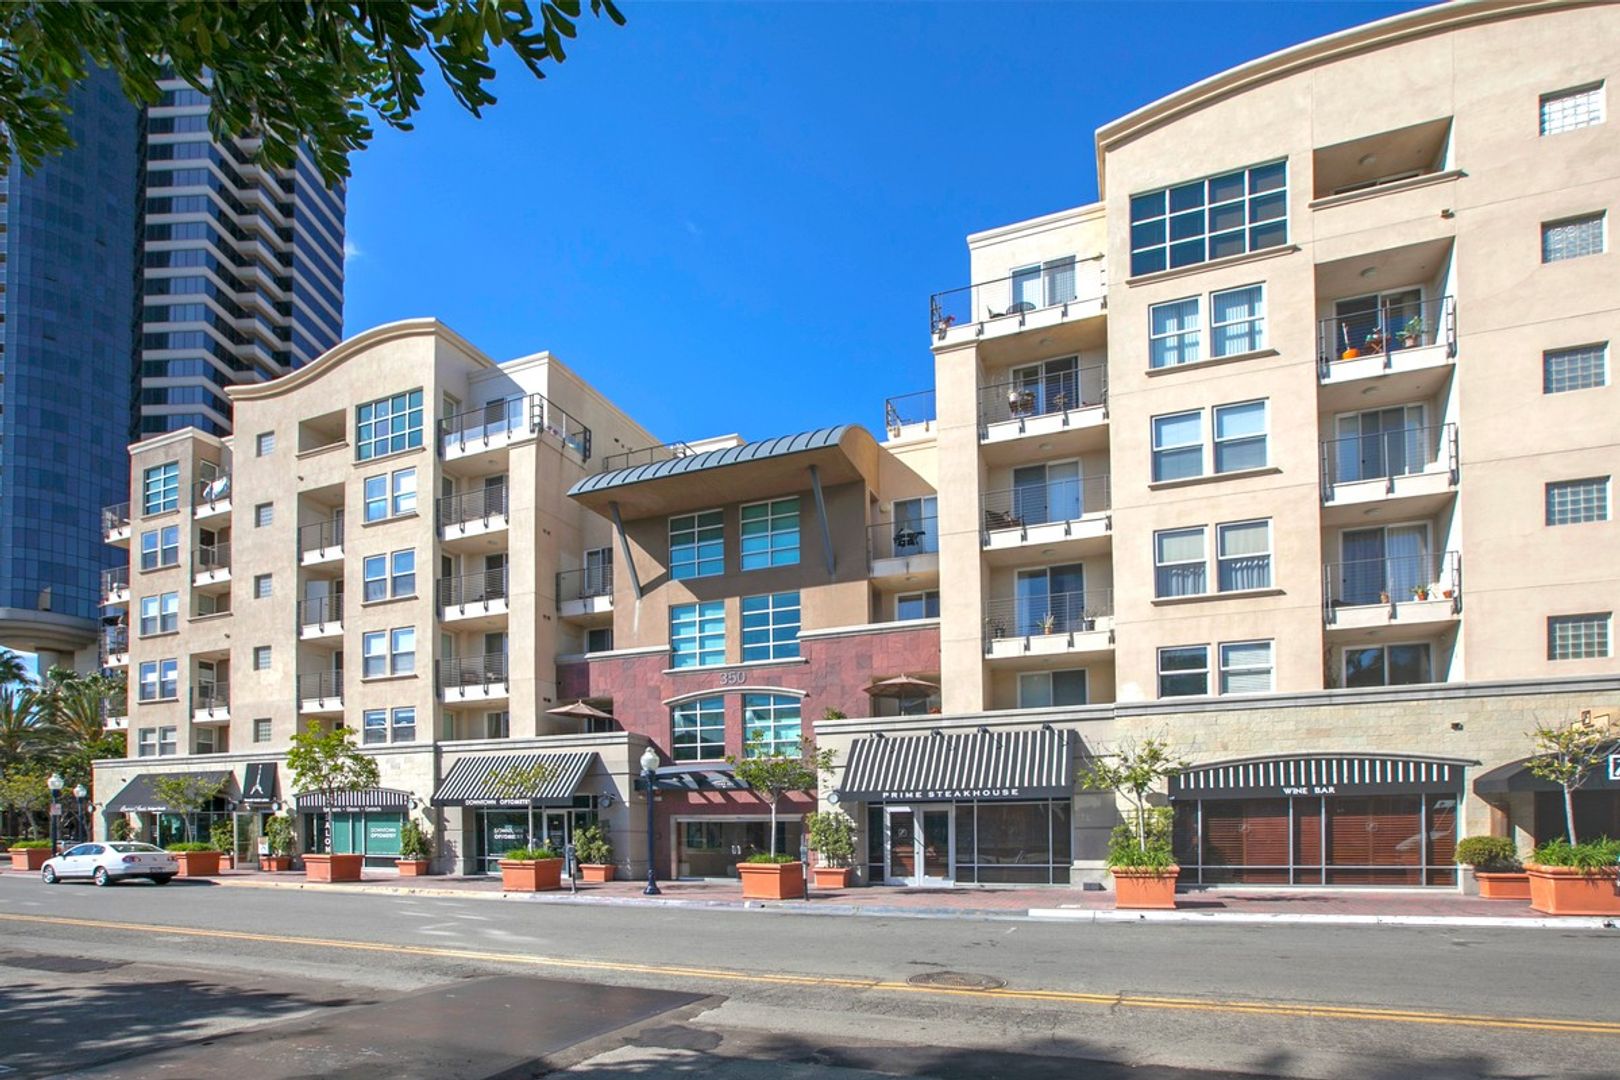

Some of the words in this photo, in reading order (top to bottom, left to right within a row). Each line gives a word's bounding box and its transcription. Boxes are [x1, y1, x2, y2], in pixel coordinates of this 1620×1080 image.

[720, 671, 746, 685] 350
[928, 788, 1019, 798] STEAKHOUSE
[1282, 787, 1308, 795] WINE
[1314, 786, 1336, 794] BAR
